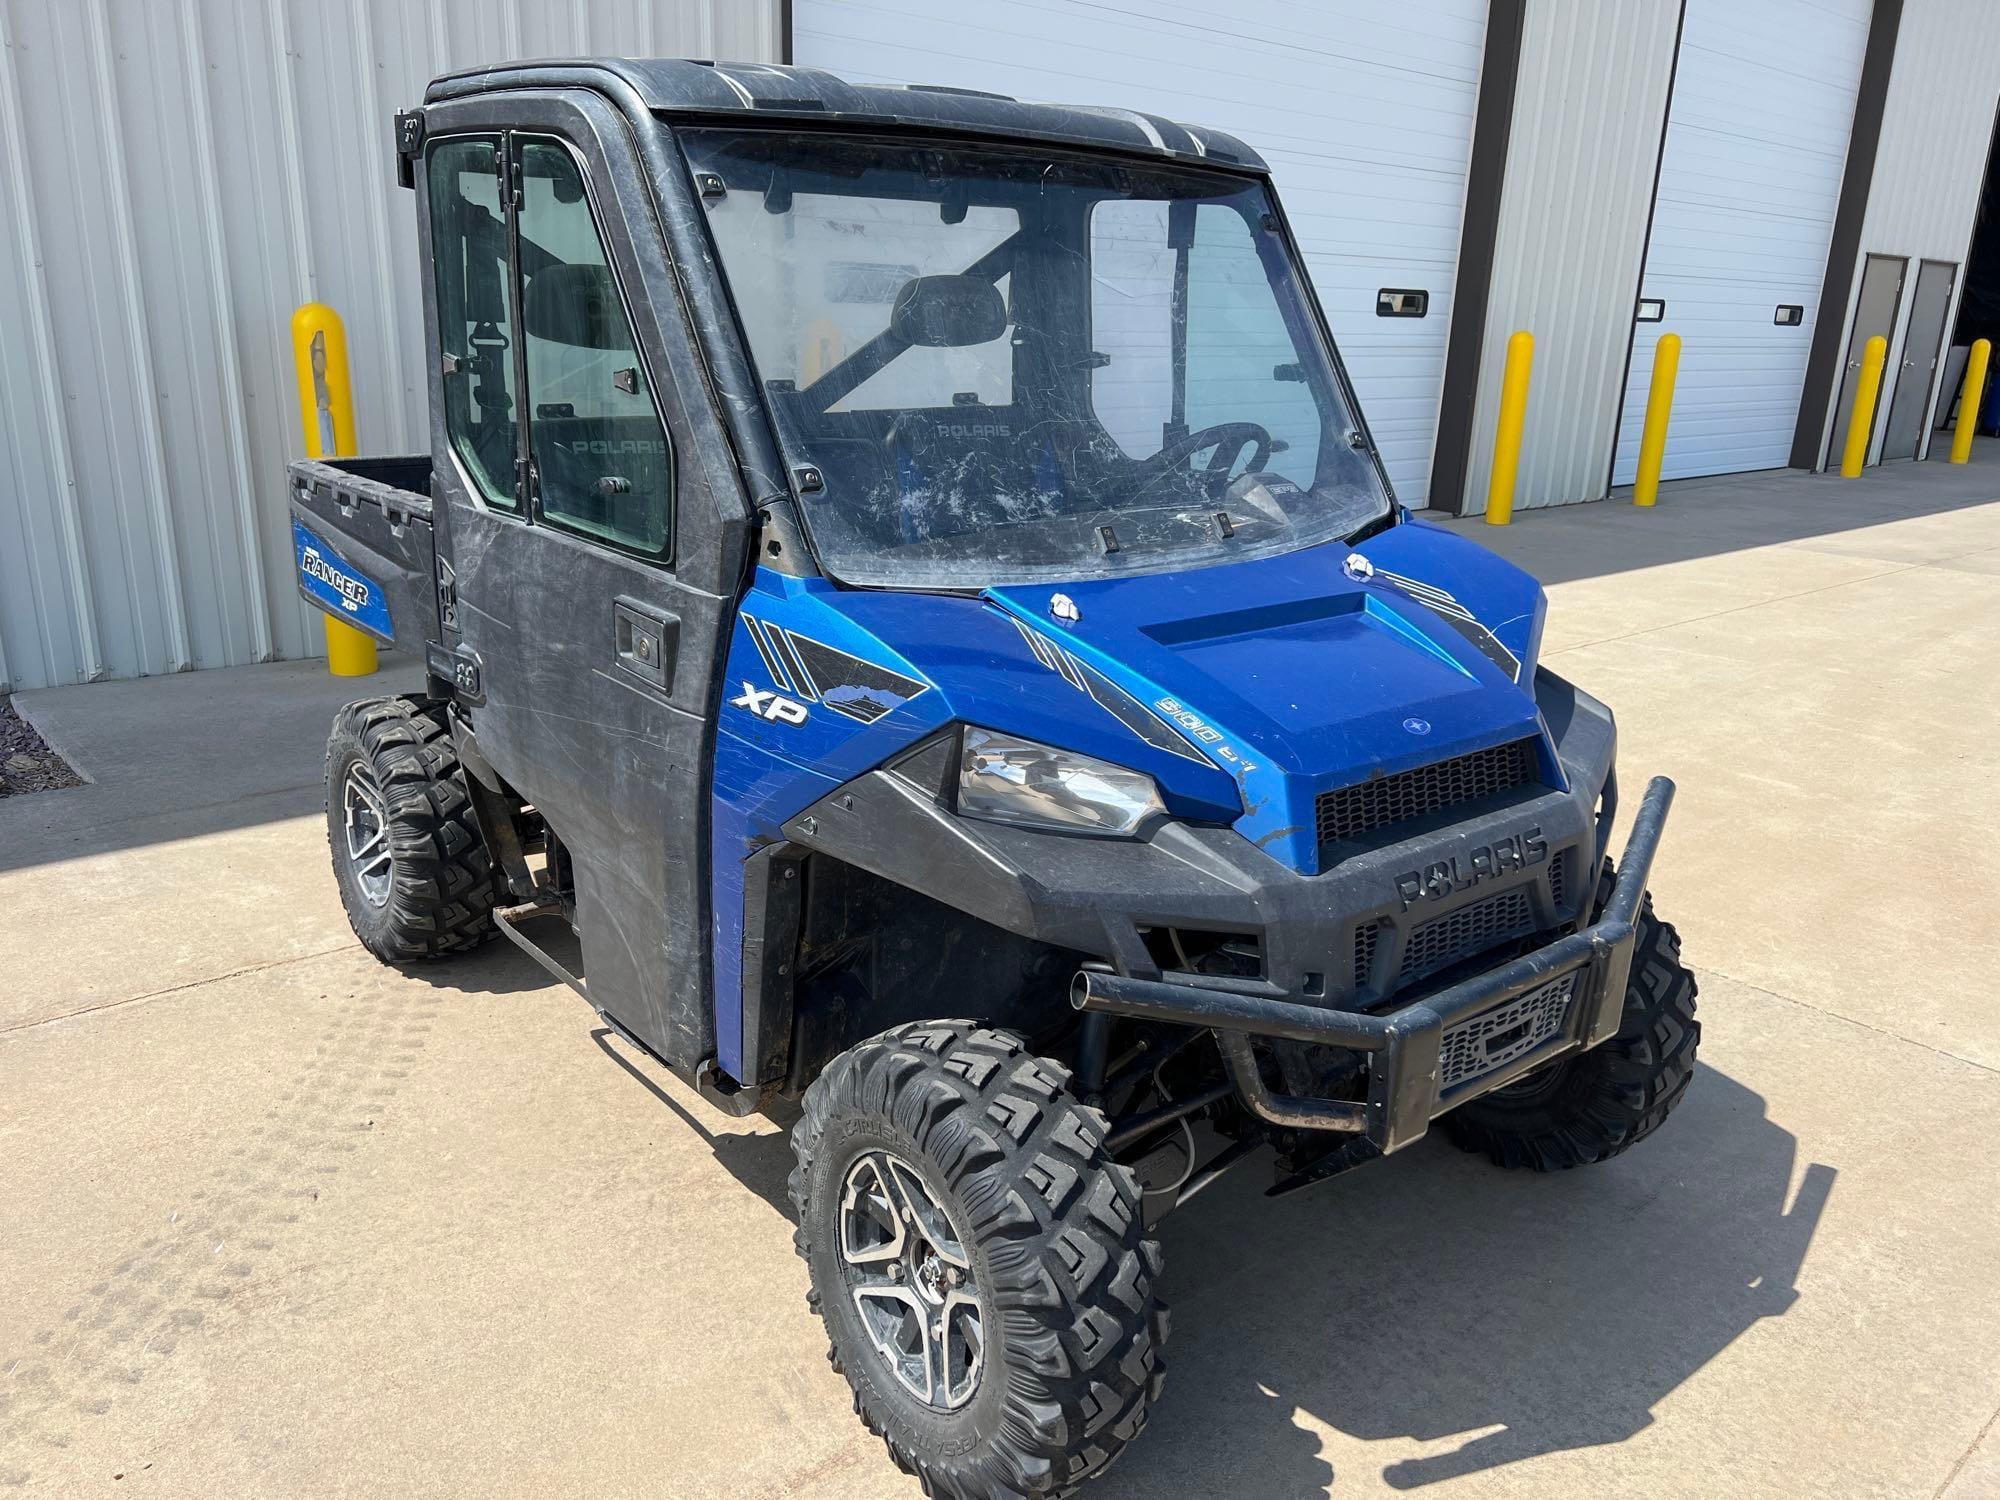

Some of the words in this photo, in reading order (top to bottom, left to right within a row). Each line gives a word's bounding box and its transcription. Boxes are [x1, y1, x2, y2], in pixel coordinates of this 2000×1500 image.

[937, 424, 1010, 437] POLARIS
[303, 552, 368, 606] RANGER
[341, 597, 358, 612] XP
[729, 681, 808, 724] XP
[1154, 697, 1224, 744] 900
[1394, 827, 1549, 914] POLARIS
